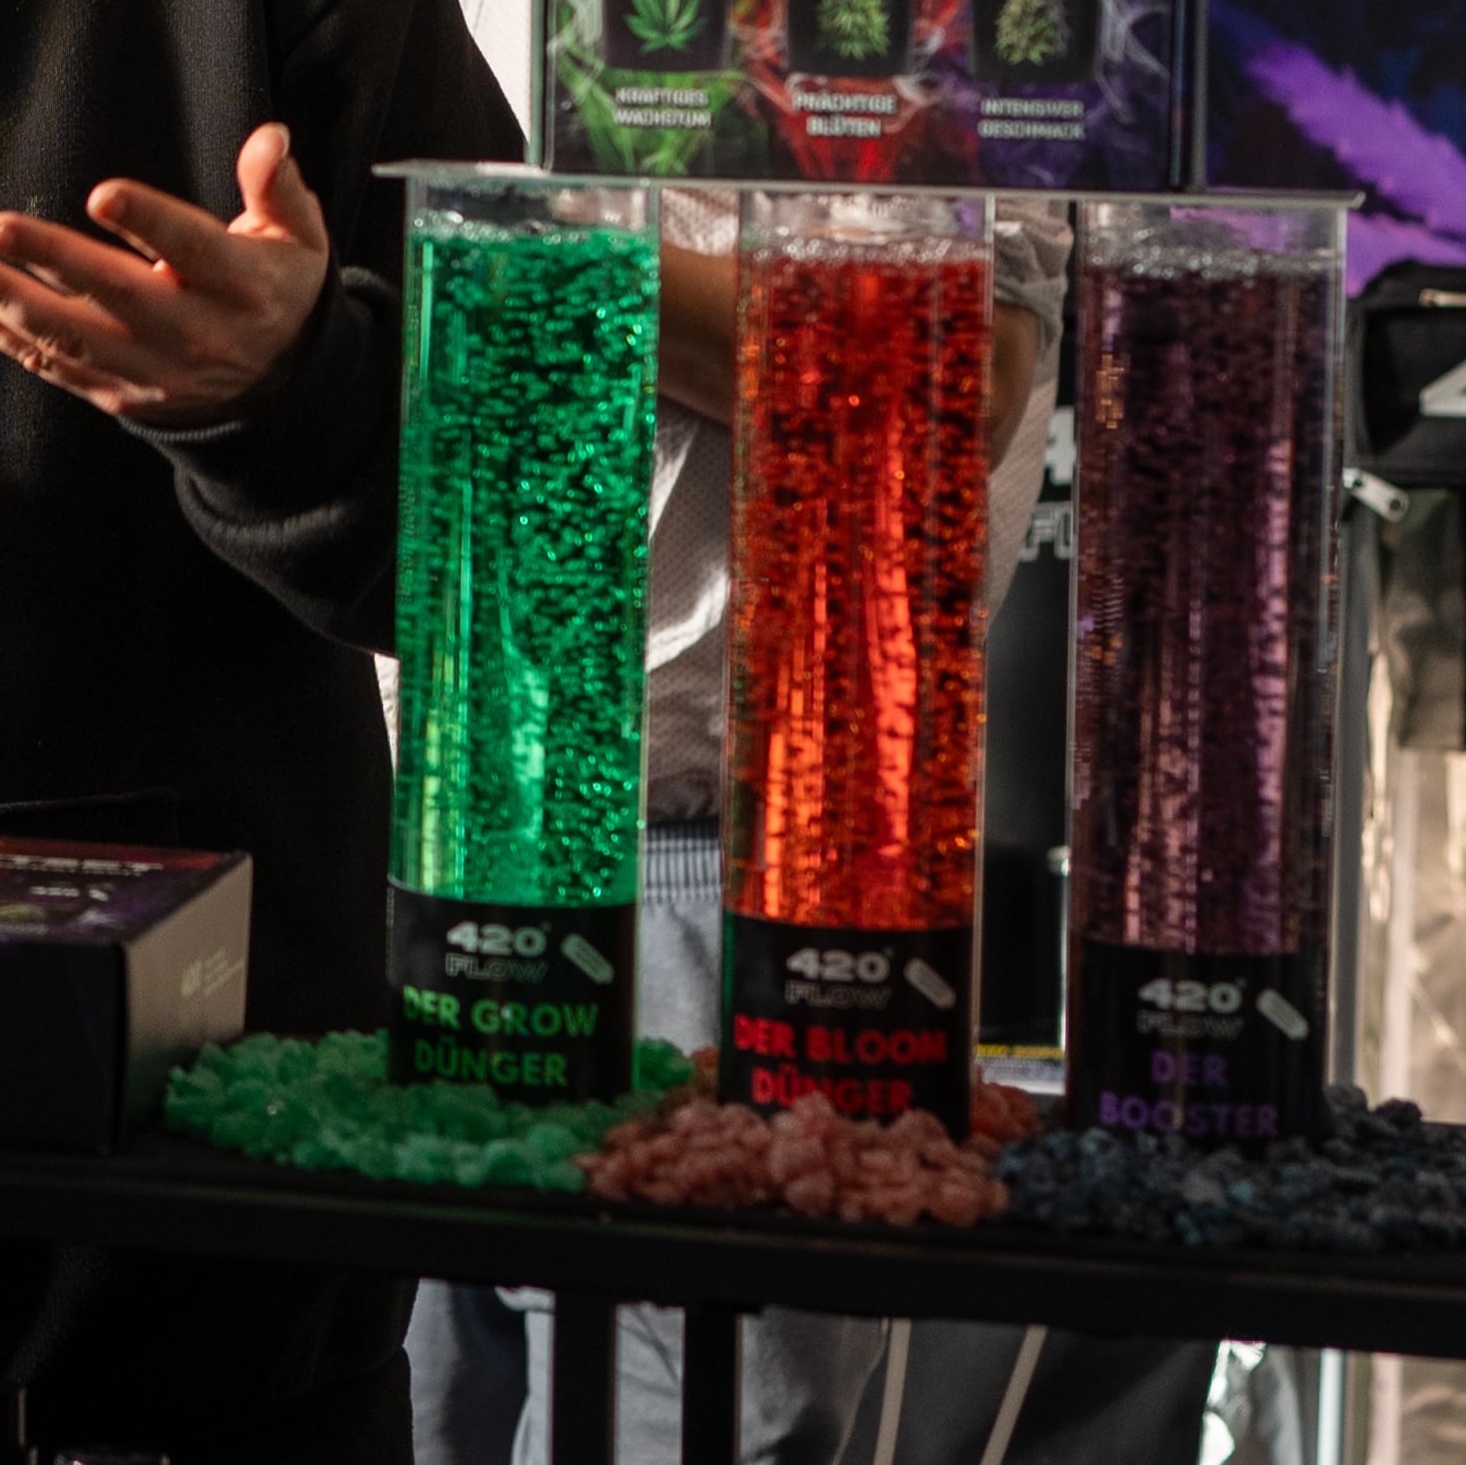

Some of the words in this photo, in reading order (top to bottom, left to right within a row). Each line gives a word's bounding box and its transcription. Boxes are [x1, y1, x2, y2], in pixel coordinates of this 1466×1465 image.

[445, 920, 548, 958] 420
[444, 951, 550, 984] FLOW
[784, 947, 892, 984] 420
[401, 983, 461, 1031] DER
[470, 997, 601, 1039] GROW
[783, 978, 894, 1011] FLOW
[1136, 977, 1244, 1015] 420
[733, 1012, 797, 1060] DER
[805, 1024, 949, 1066] BLOOM
[1135, 1008, 1246, 1041] FLOW
[413, 1033, 569, 1088] DÜNGER
[1148, 1046, 1230, 1087] DER
[1097, 1086, 1279, 1140] BOOSTER
